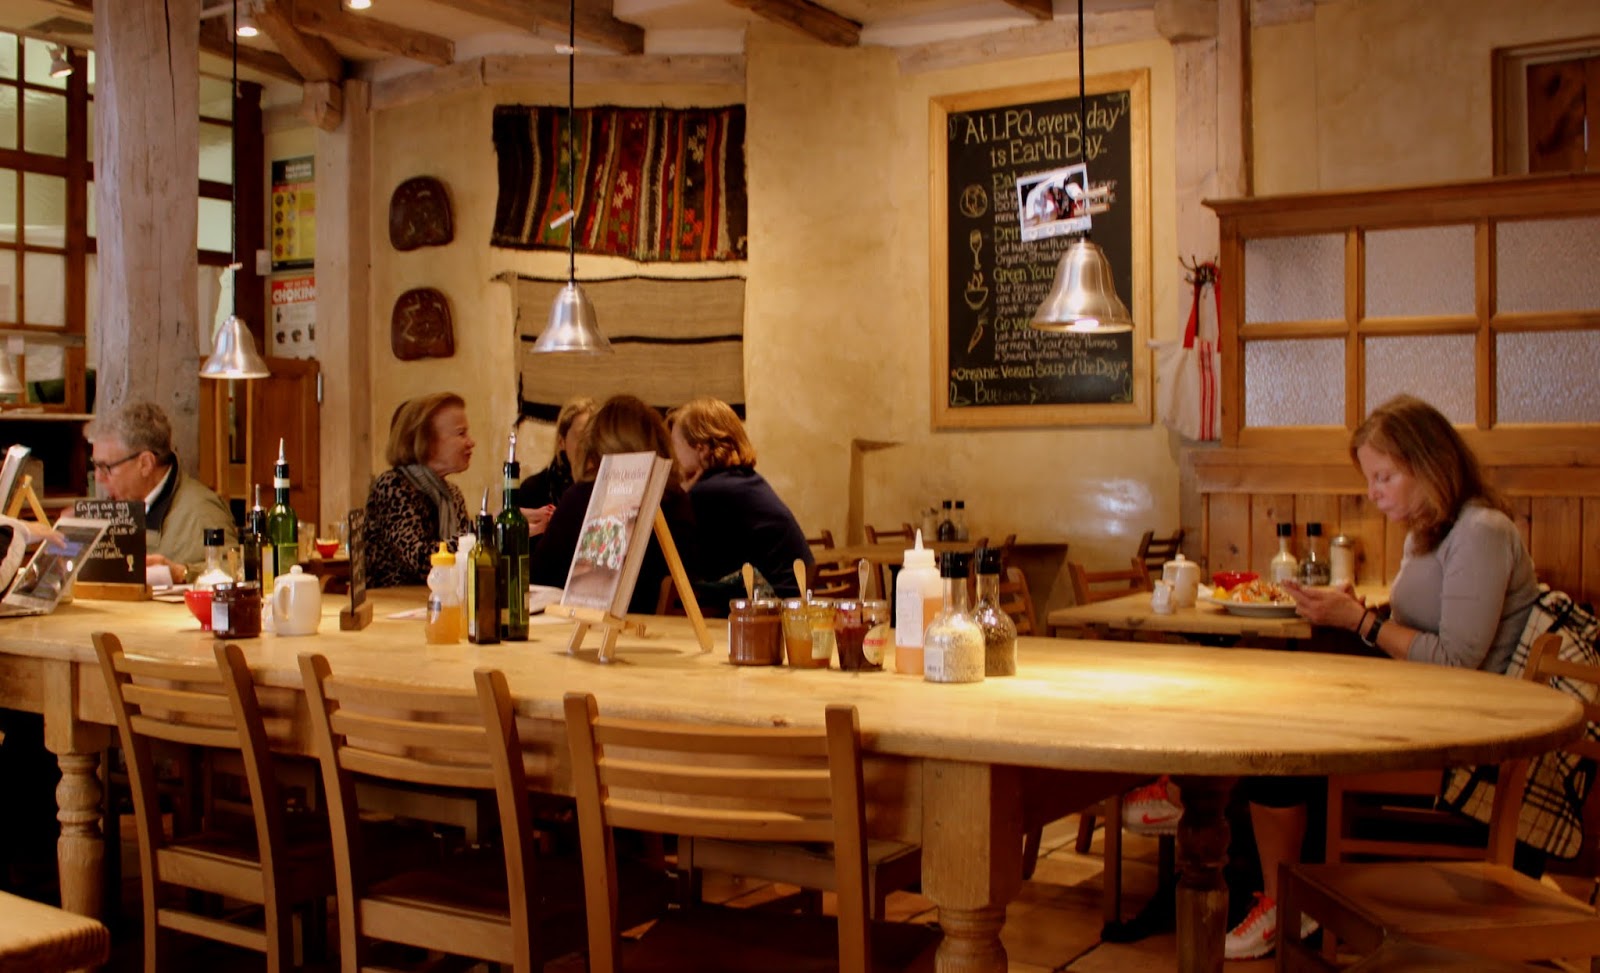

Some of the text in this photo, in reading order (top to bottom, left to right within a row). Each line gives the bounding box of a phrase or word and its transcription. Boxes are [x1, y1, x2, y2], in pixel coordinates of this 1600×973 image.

[1037, 112, 1081, 136] every
[1086, 101, 1120, 132] day
[990, 146, 1007, 168] is
[1010, 133, 1061, 165] Earth
[993, 265, 1028, 285] Green
